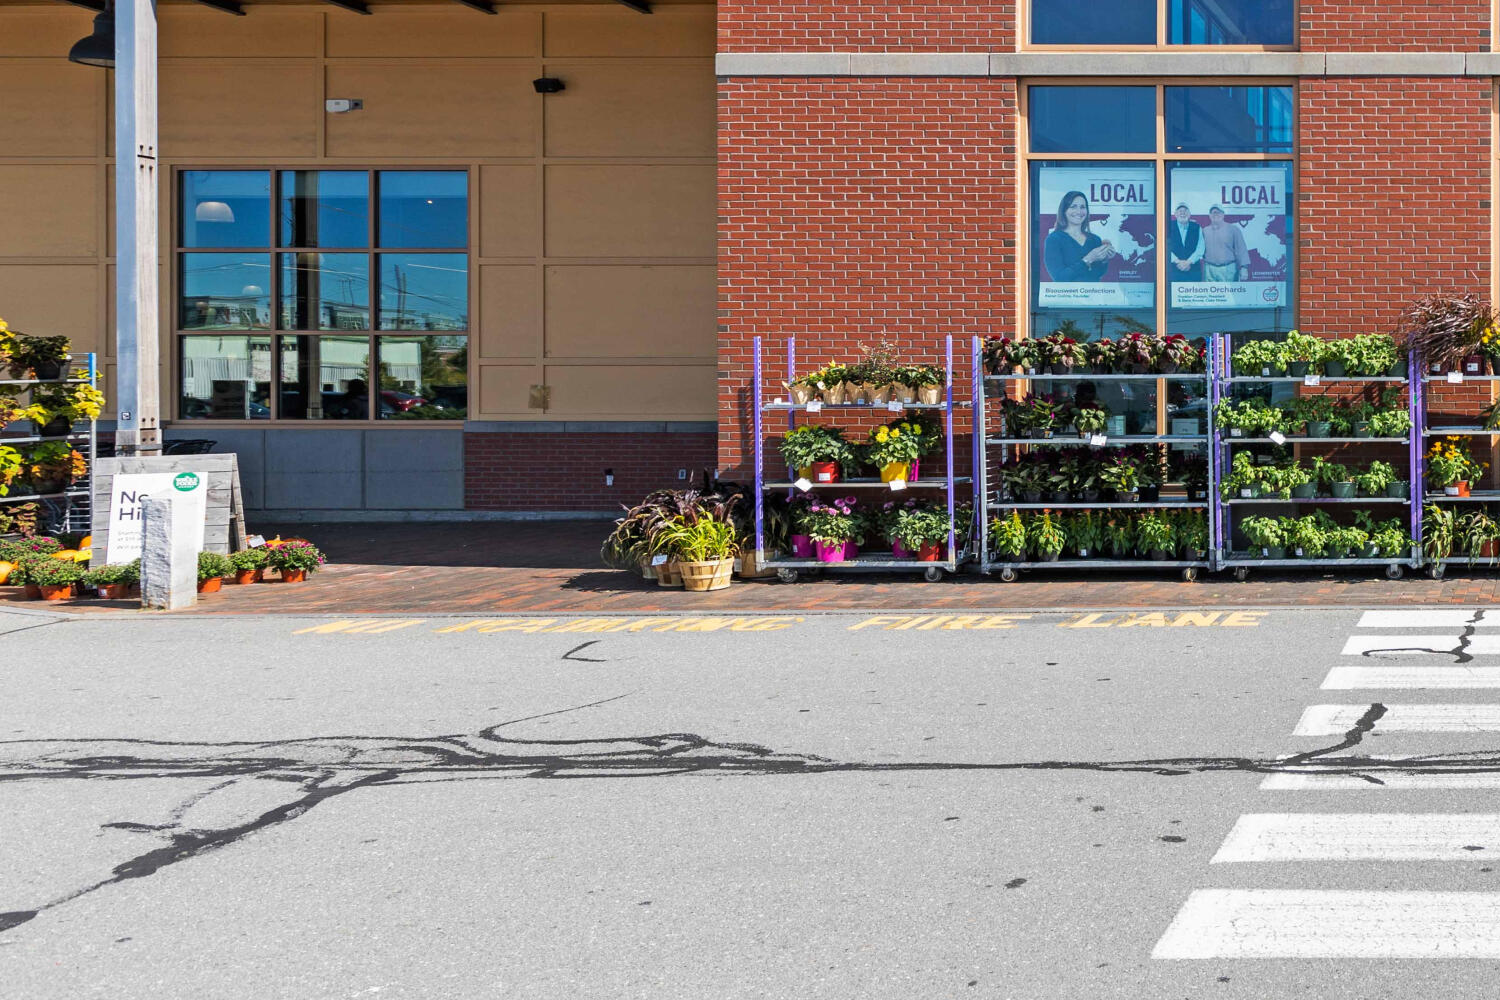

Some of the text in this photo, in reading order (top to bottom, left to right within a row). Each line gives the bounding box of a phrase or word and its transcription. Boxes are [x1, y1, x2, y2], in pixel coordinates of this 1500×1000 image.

[1090, 183, 1149, 203] LOCAL
[1221, 185, 1280, 205] LOCAL
[119, 507, 143, 521] Hi
[846, 615, 1033, 631] FIRE
[1058, 611, 1269, 628] LANE
